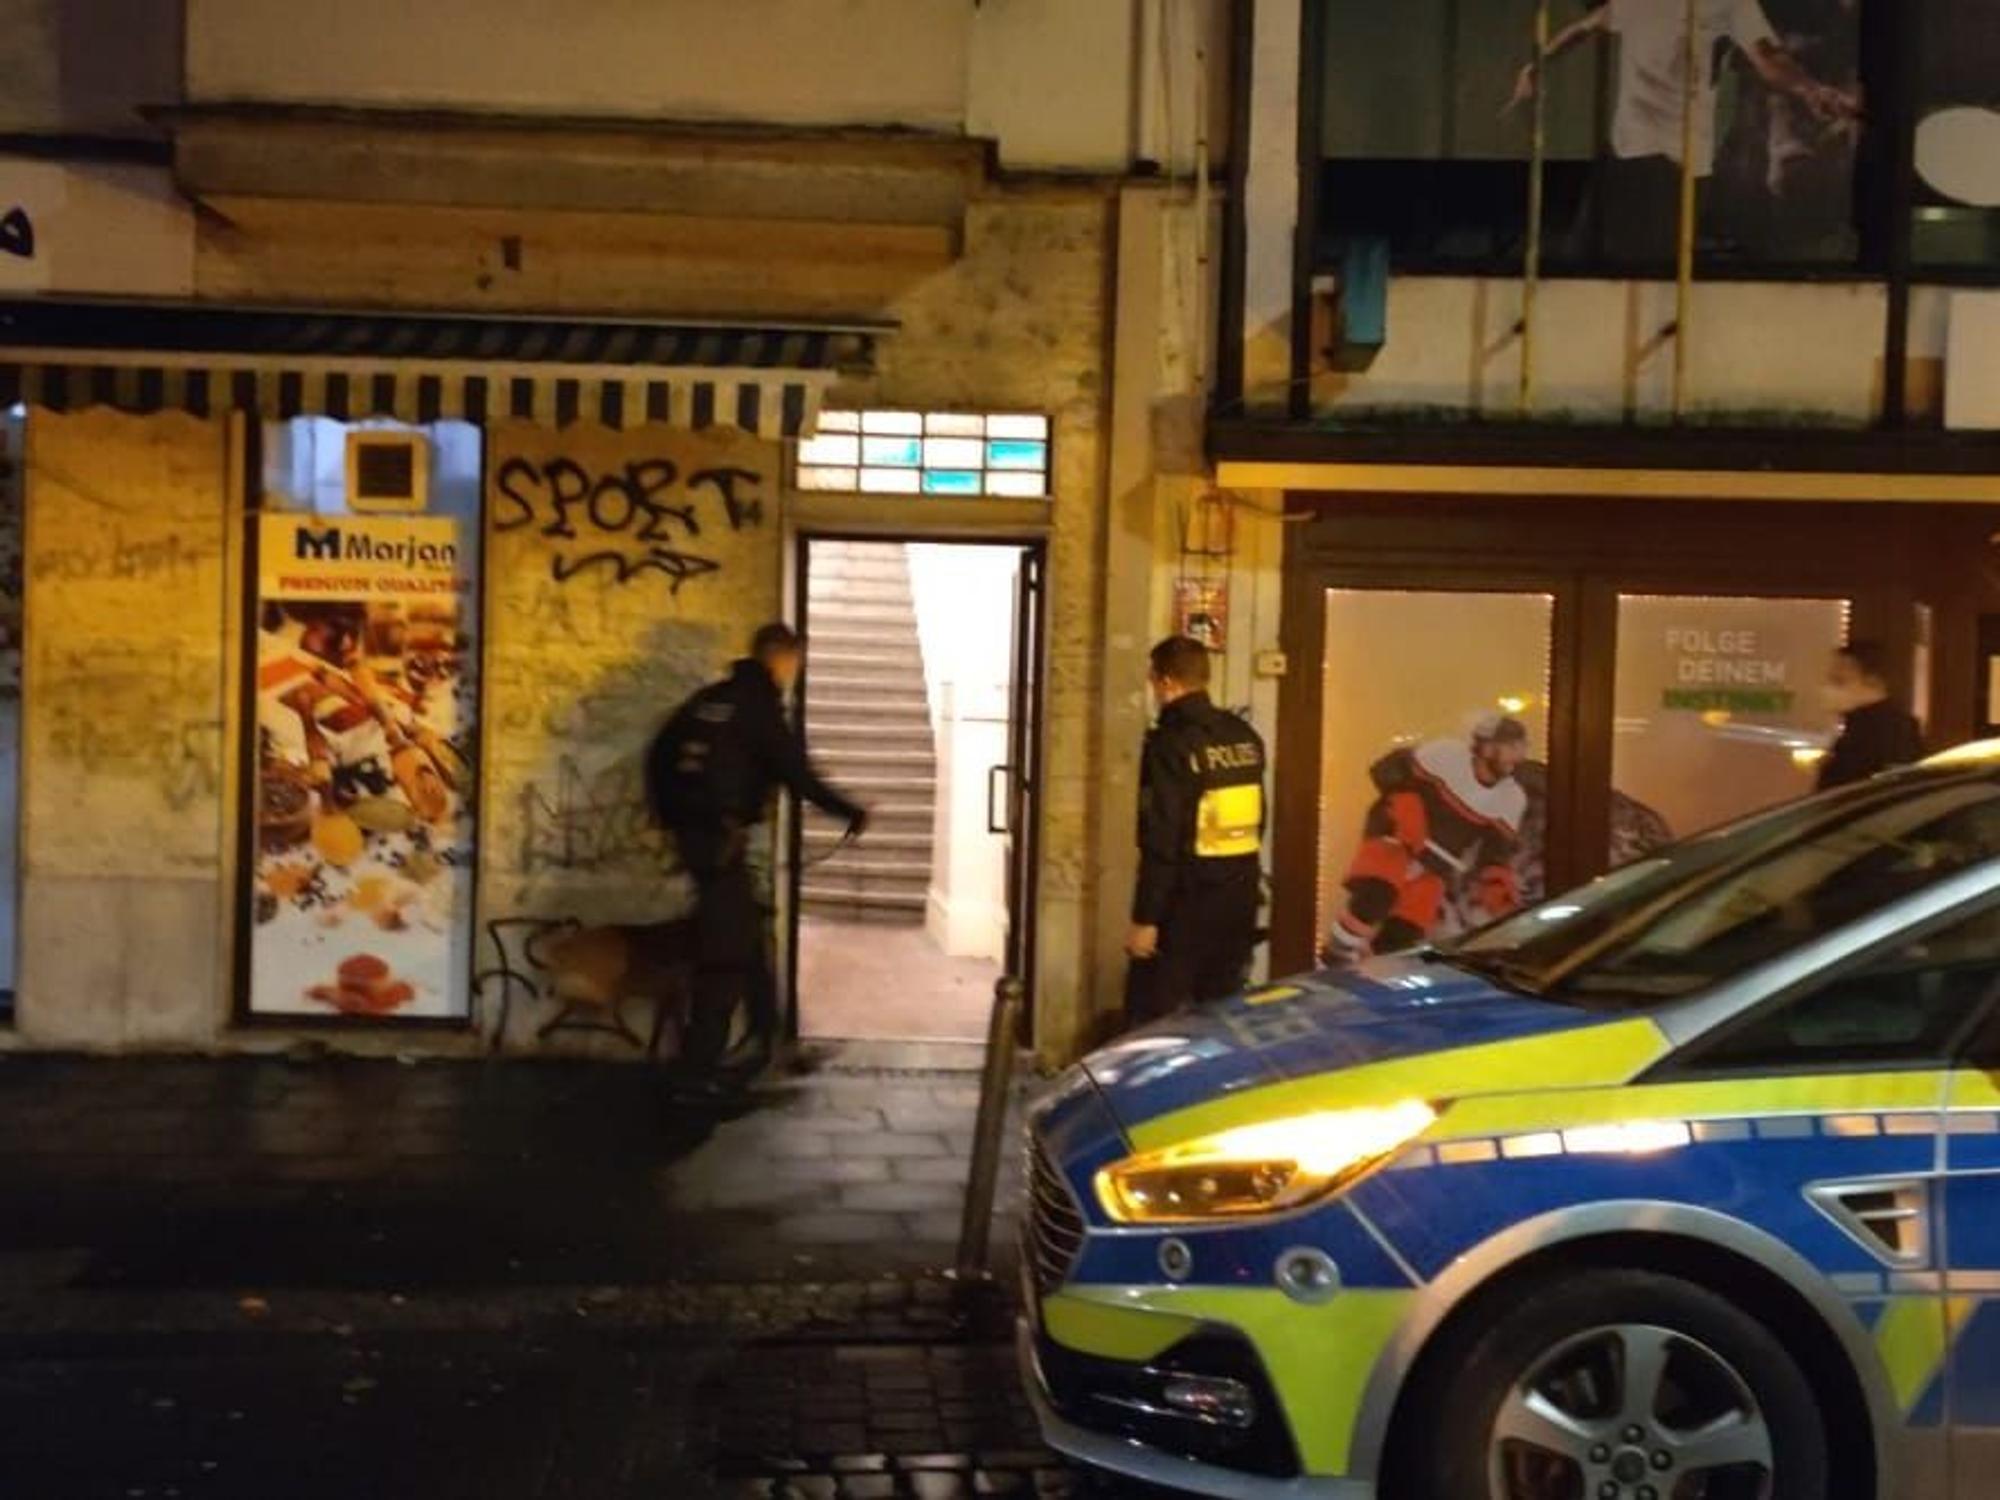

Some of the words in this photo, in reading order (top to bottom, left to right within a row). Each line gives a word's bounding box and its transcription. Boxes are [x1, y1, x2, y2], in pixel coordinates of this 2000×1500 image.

[494, 457, 761, 541] SPORT
[346, 533, 456, 569] Marjan
[1665, 629, 1756, 653] FOLGE
[1677, 659, 1786, 684] DEINEM
